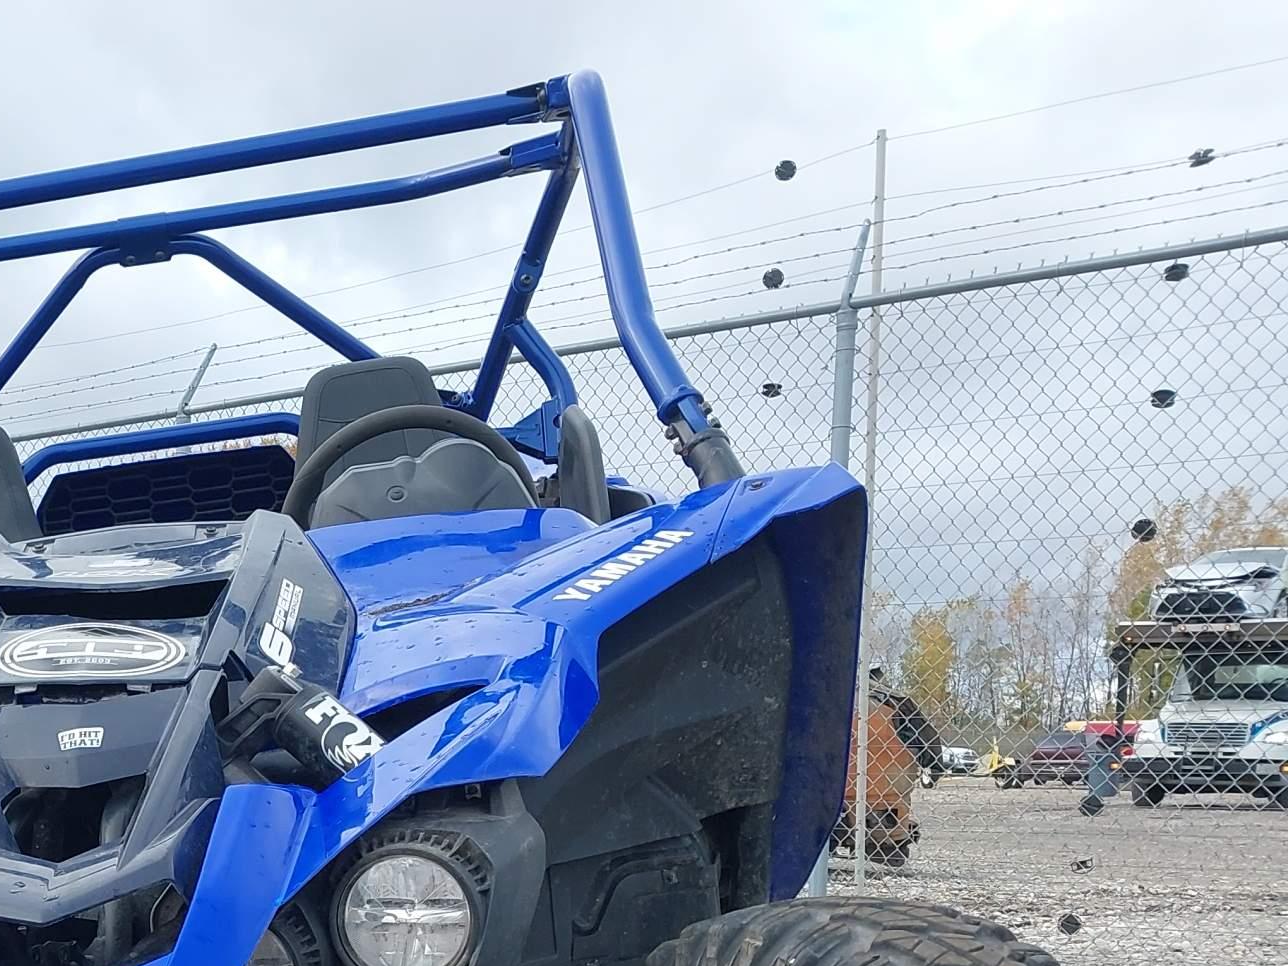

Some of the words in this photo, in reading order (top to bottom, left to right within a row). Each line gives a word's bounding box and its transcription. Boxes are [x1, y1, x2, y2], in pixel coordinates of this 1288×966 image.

[553, 528, 694, 602] YAMAHA
[272, 577, 295, 631] SPEED
[259, 621, 293, 667] 6
[60, 738, 101, 750] THAT!
[78, 730, 102, 738] HIT
